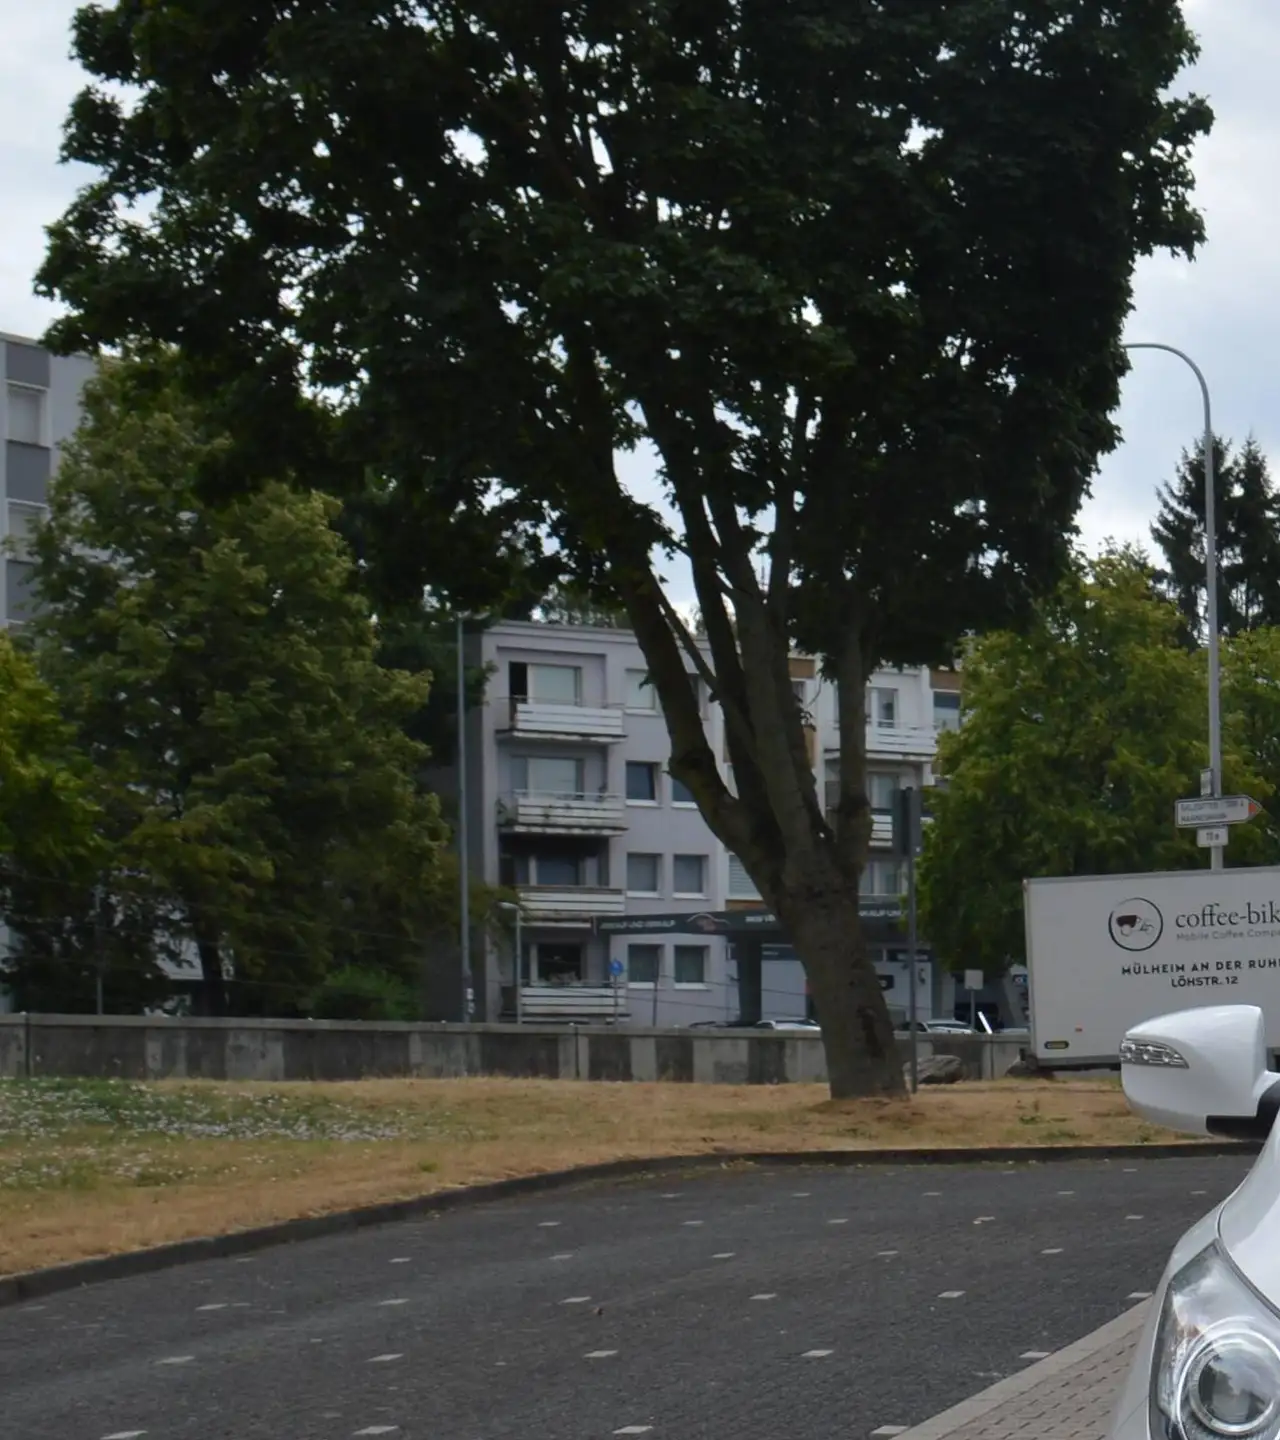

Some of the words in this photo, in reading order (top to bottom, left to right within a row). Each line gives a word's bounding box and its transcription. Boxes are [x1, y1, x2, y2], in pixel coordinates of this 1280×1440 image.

[1211, 929, 1244, 940] Coffee
[1121, 962, 1186, 976] MÜLHEIM
[1191, 961, 1210, 972] AN
[1216, 959, 1242, 971] DER
[1171, 975, 1223, 988] LÖHSTR.
[1225, 975, 1239, 985] 12
